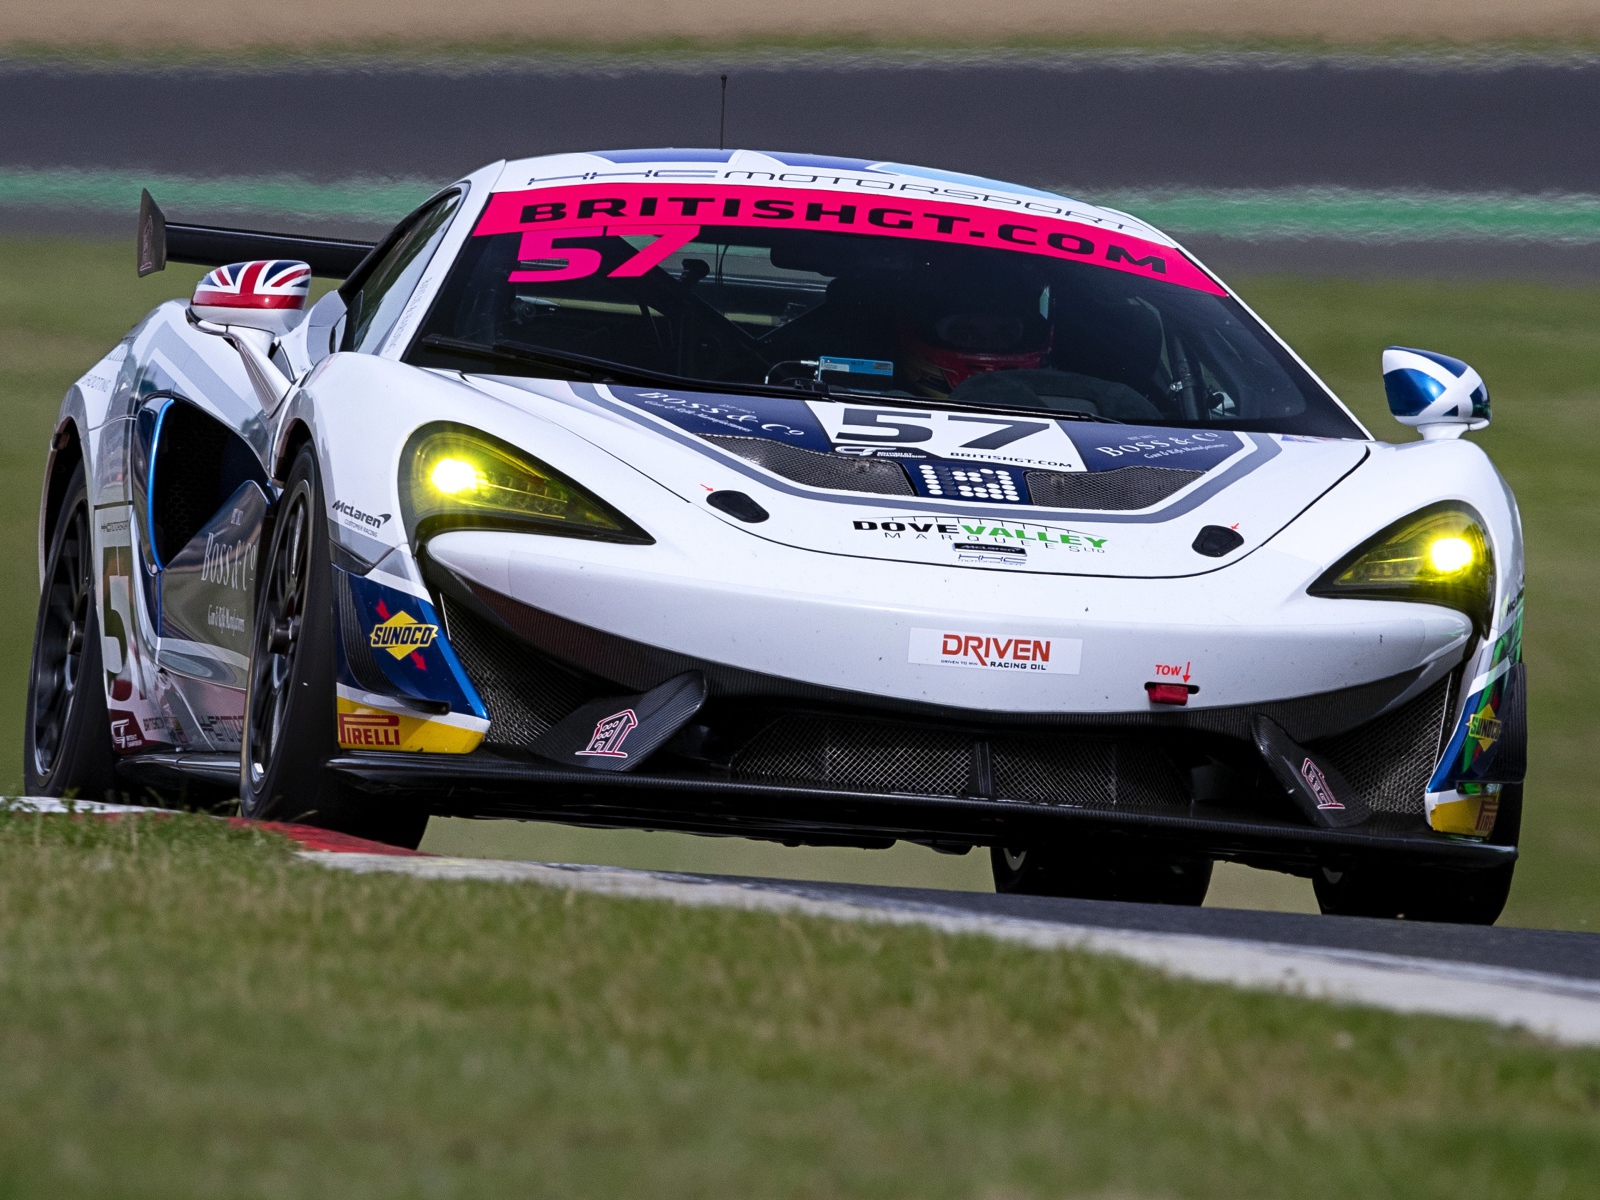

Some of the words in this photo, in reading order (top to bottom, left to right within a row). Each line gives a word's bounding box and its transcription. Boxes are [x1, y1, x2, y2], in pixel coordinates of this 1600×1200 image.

[518, 197, 1167, 275] BRITISHGT.COM
[508, 224, 701, 283] 57
[835, 408, 1050, 450] 57
[950, 452, 1073, 469] BRITISHGT.COM
[331, 499, 382, 530] McLaren
[372, 626, 435, 645] SUNOCO
[942, 633, 1051, 666] DRIVEN
[989, 661, 1027, 670] RACING
[1030, 663, 1047, 671] OIL
[1155, 664, 1183, 676] TOW
[339, 713, 401, 746] PIRELLI
